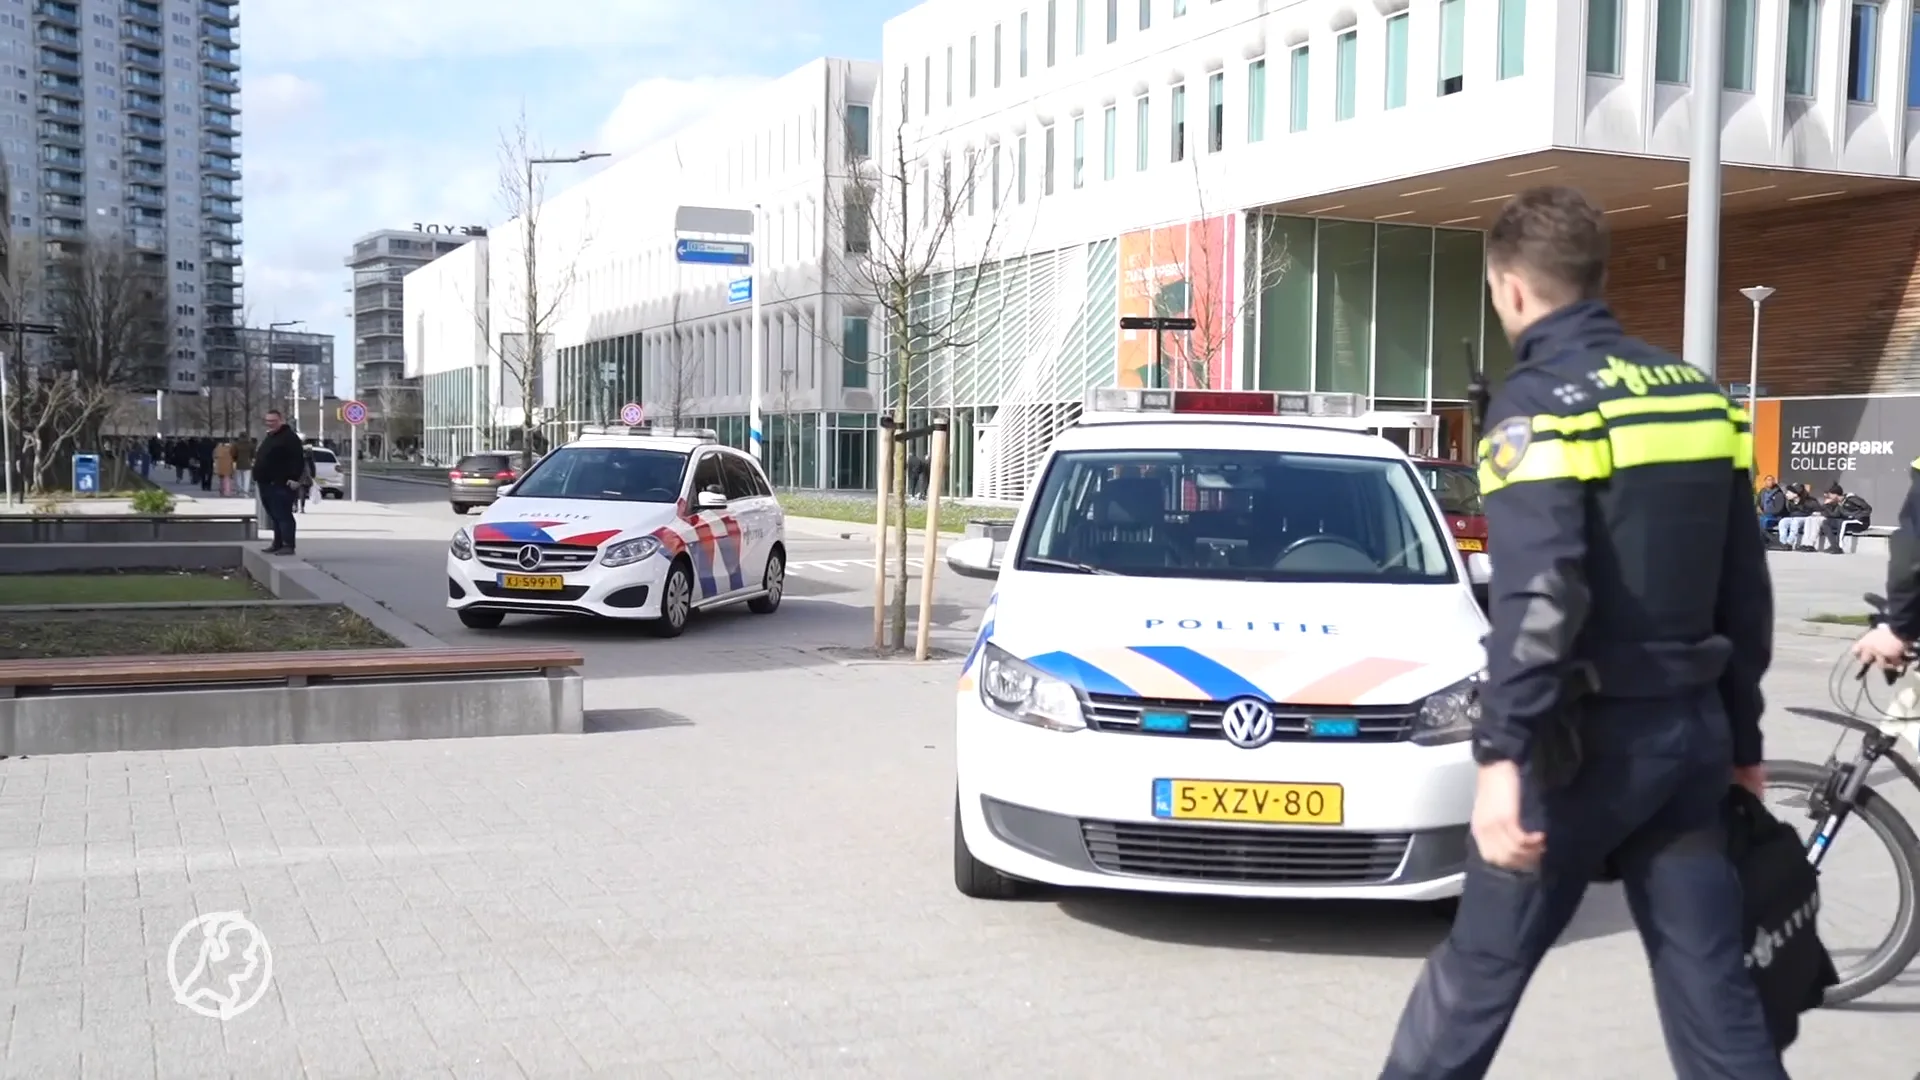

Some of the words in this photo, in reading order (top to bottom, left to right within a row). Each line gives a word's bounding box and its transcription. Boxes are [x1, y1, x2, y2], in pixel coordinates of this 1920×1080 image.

[1598, 355, 1704, 395] POLITIE
[1791, 425, 1822, 439] HET
[1790, 457, 1857, 471] COLLEGE
[1145, 619, 1340, 635] POLITIE
[1181, 786, 1324, 816] 5-XZV-80
